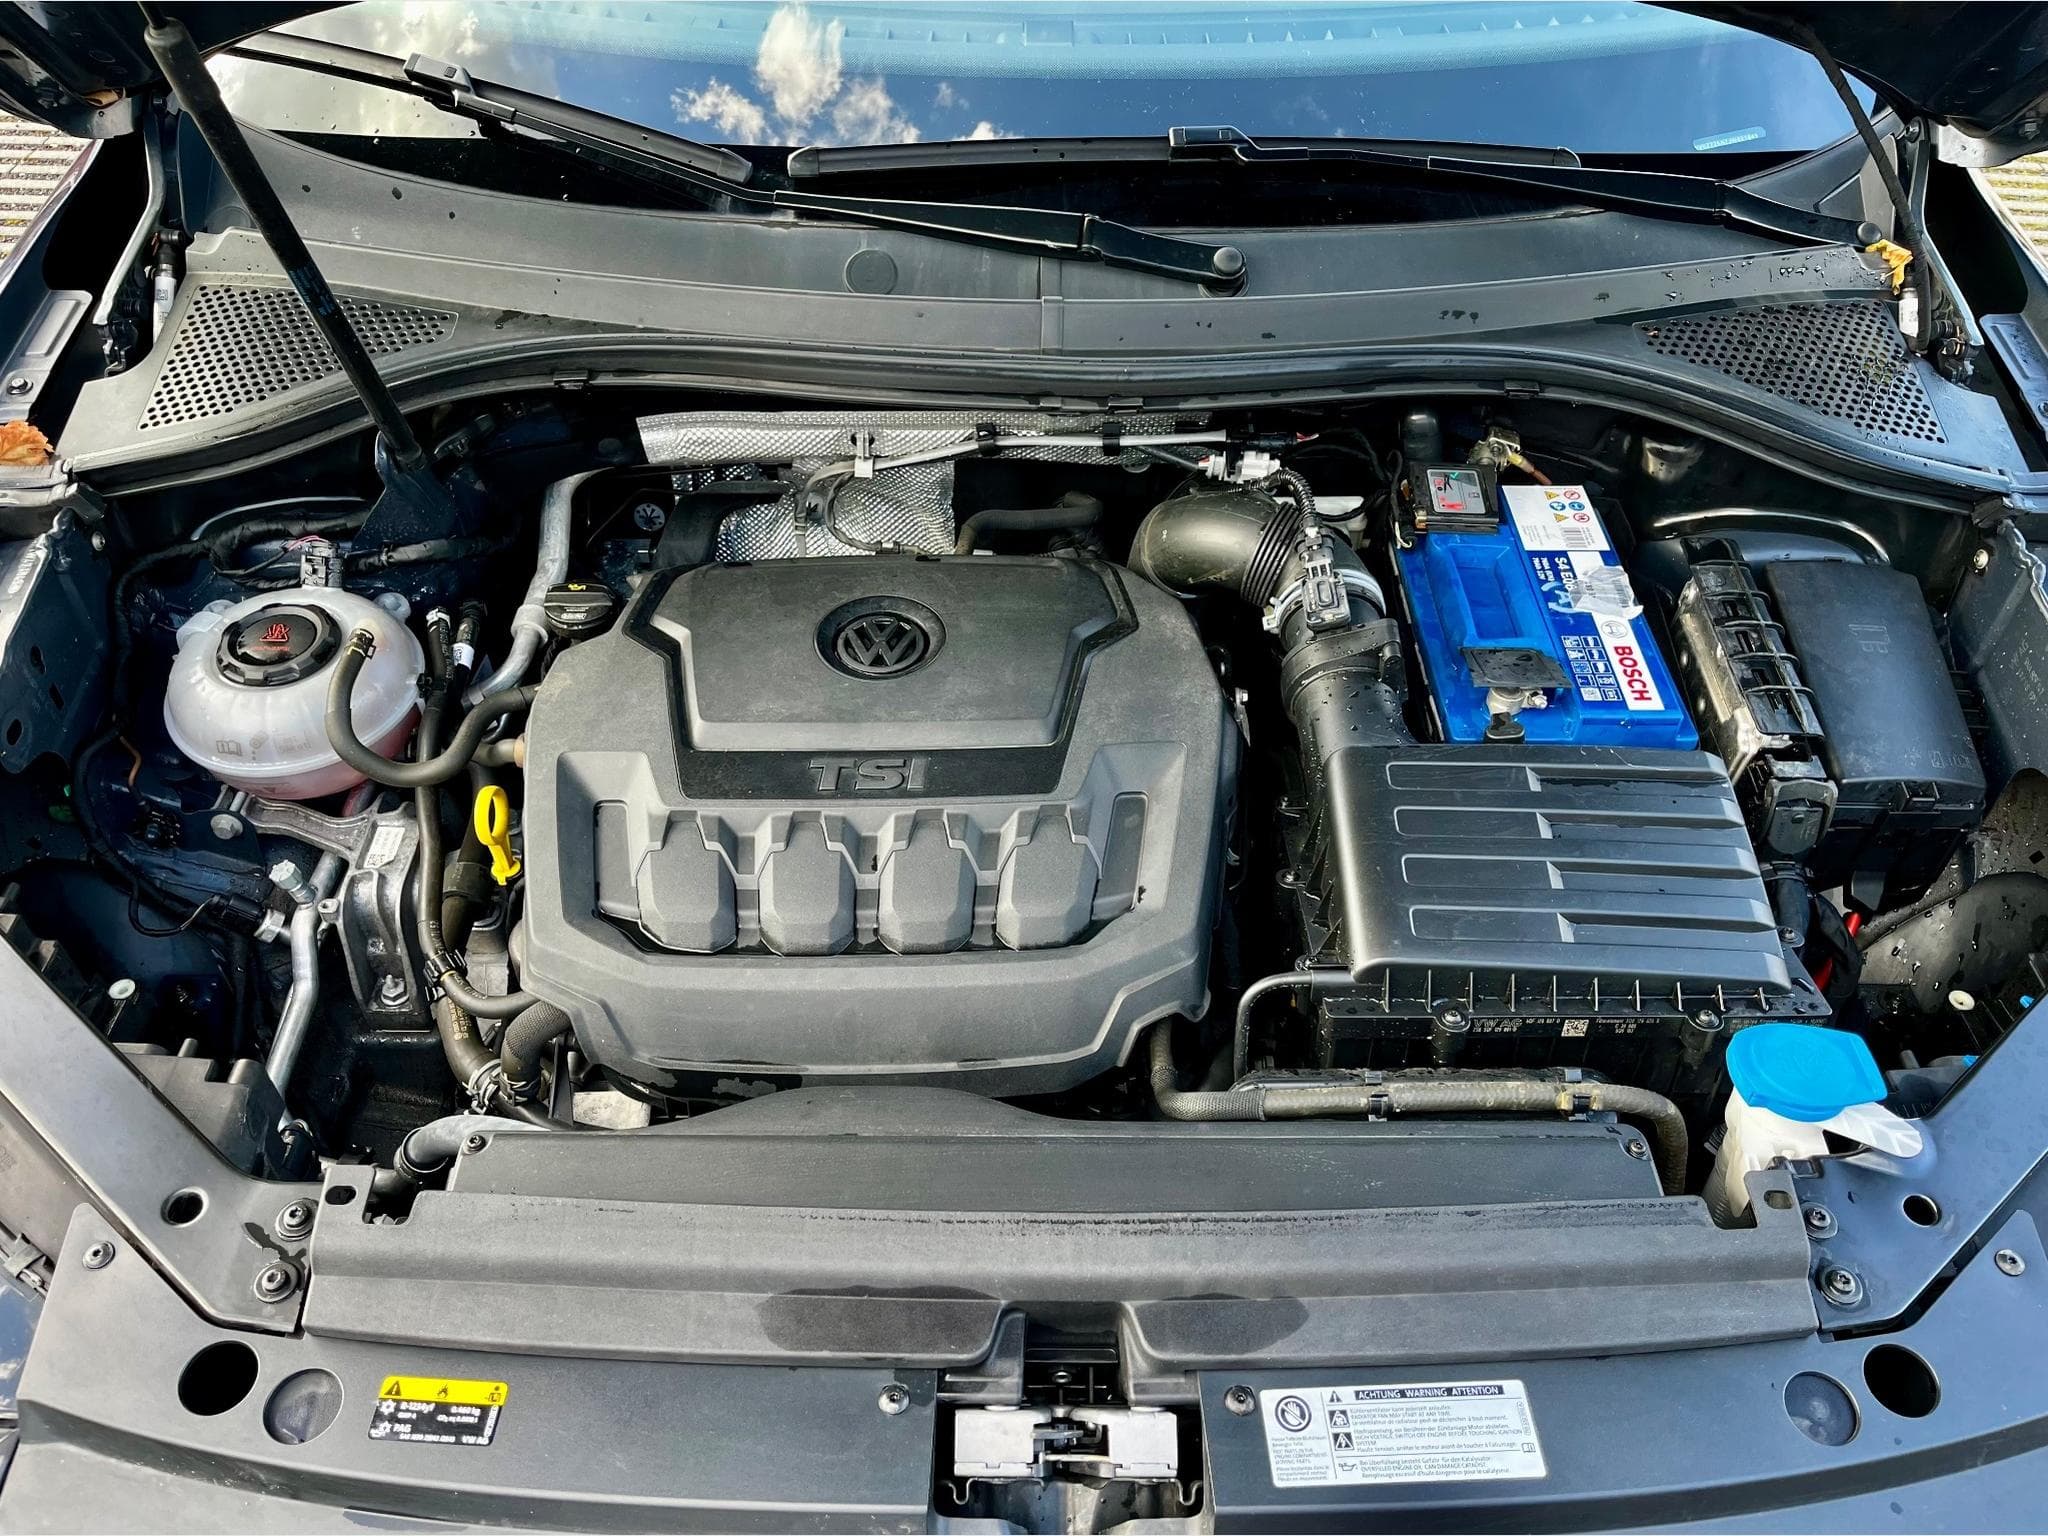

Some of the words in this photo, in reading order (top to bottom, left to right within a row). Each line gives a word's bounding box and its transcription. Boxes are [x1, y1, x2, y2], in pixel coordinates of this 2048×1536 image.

[1555, 557, 1570, 570] S4
[1613, 646, 1652, 701] BOSCH
[808, 757, 926, 792] TSI
[1473, 1018, 1499, 1028] VW
[1500, 1018, 1523, 1028] AG
[1358, 1390, 1401, 1400] ACHTUNG
[1405, 1387, 1448, 1398] WARNING
[1452, 1385, 1499, 1396] ATTENTION
[393, 1423, 413, 1433] PAG
[462, 1435, 477, 1444] VW
[476, 1436, 490, 1445] AG
